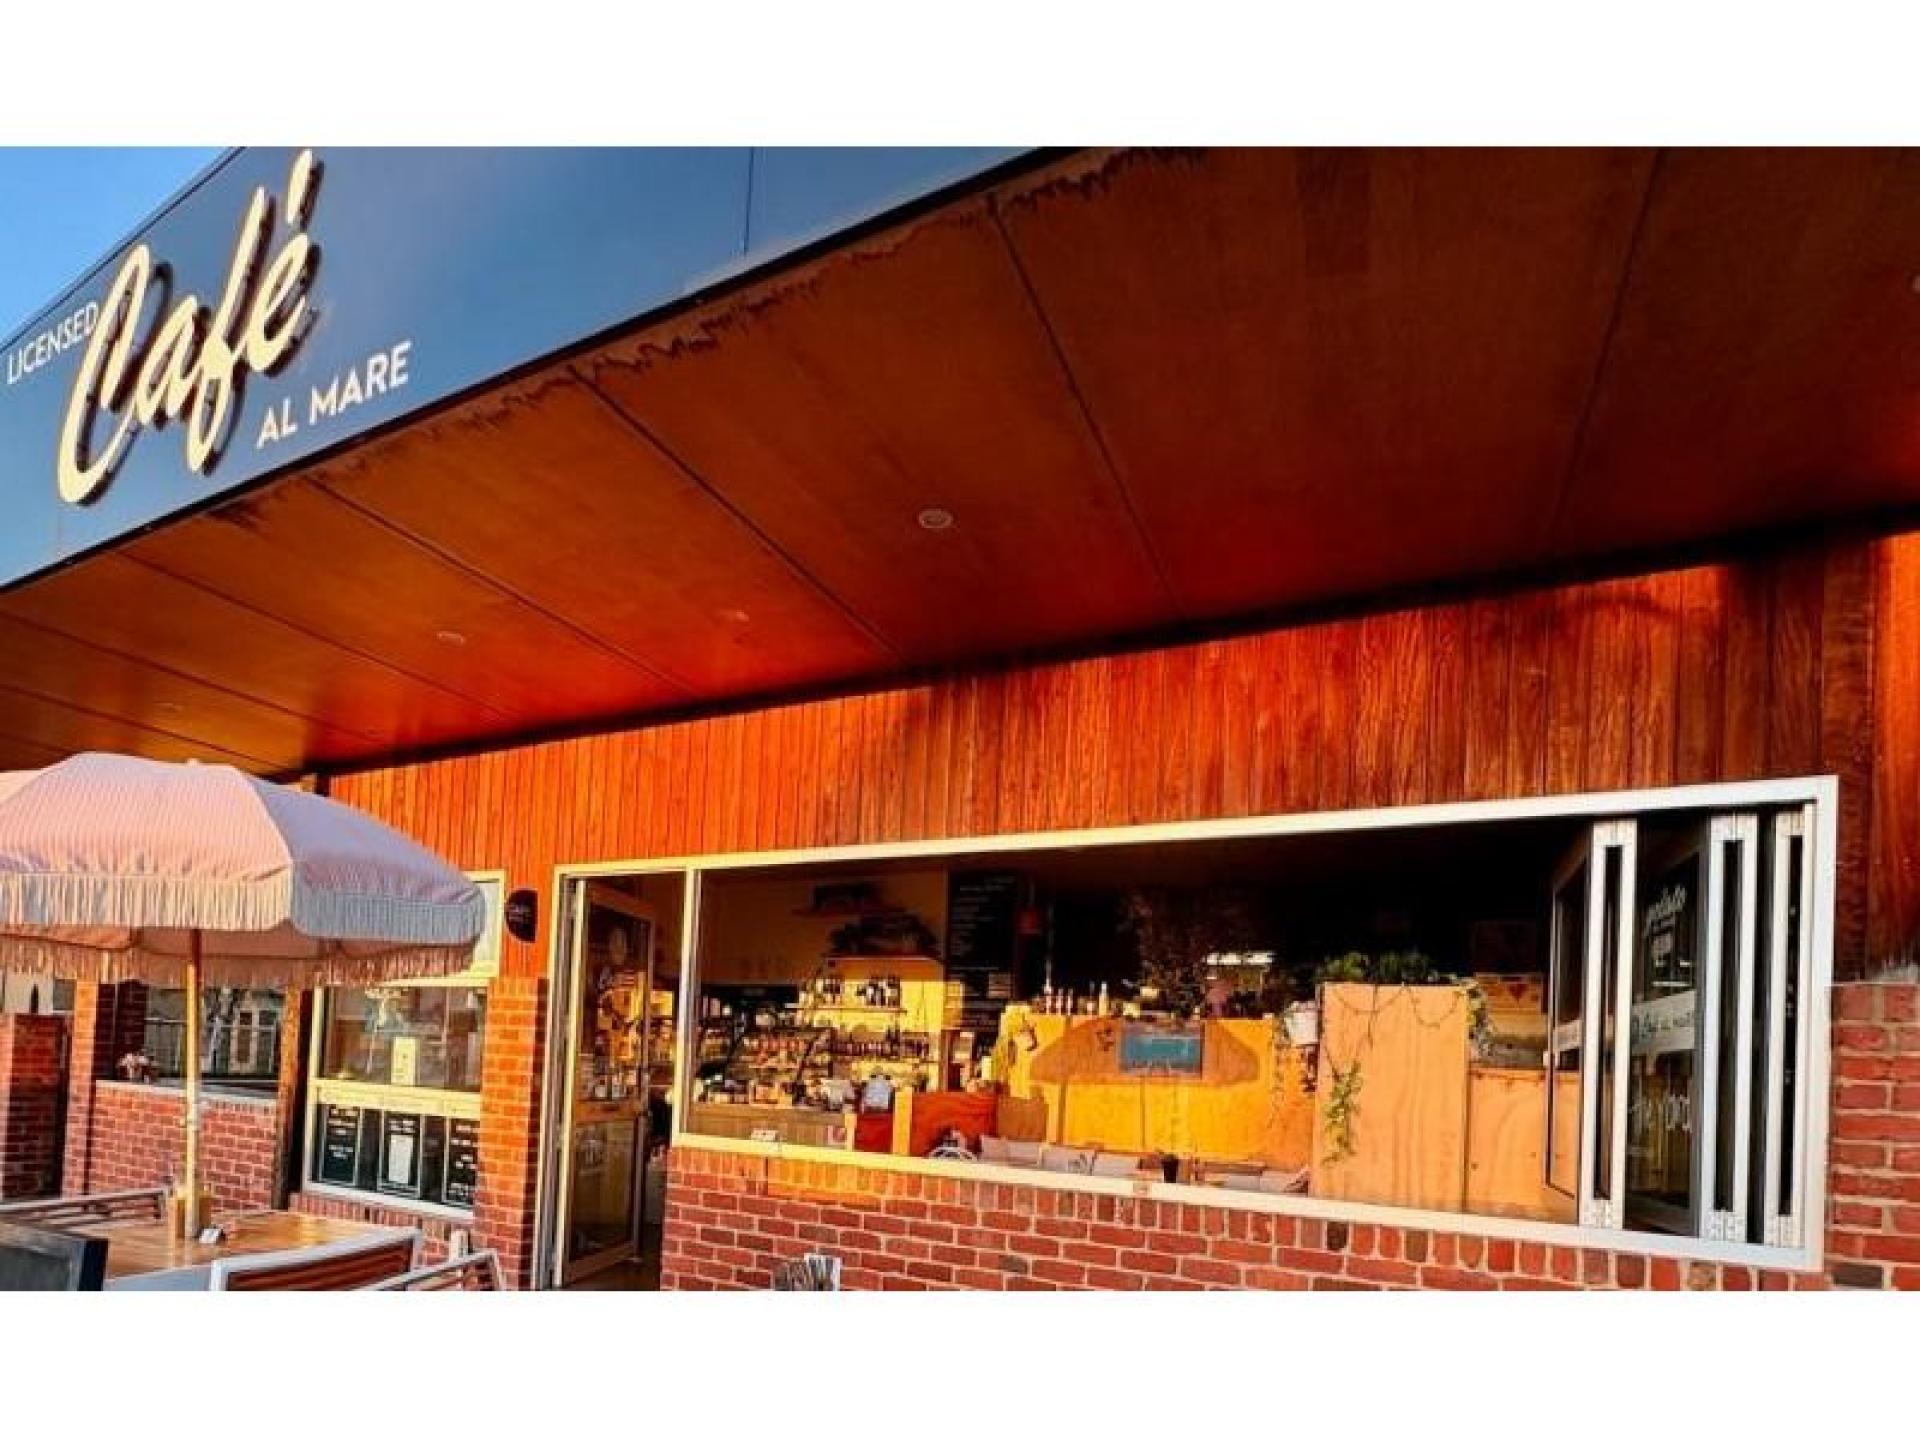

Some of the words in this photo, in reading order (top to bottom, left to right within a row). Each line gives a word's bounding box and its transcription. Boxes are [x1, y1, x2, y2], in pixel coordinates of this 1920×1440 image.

[7, 302, 98, 385] LICENSED
[58, 147, 316, 503] Café
[257, 401, 298, 449] AL
[309, 340, 412, 425] MARE
